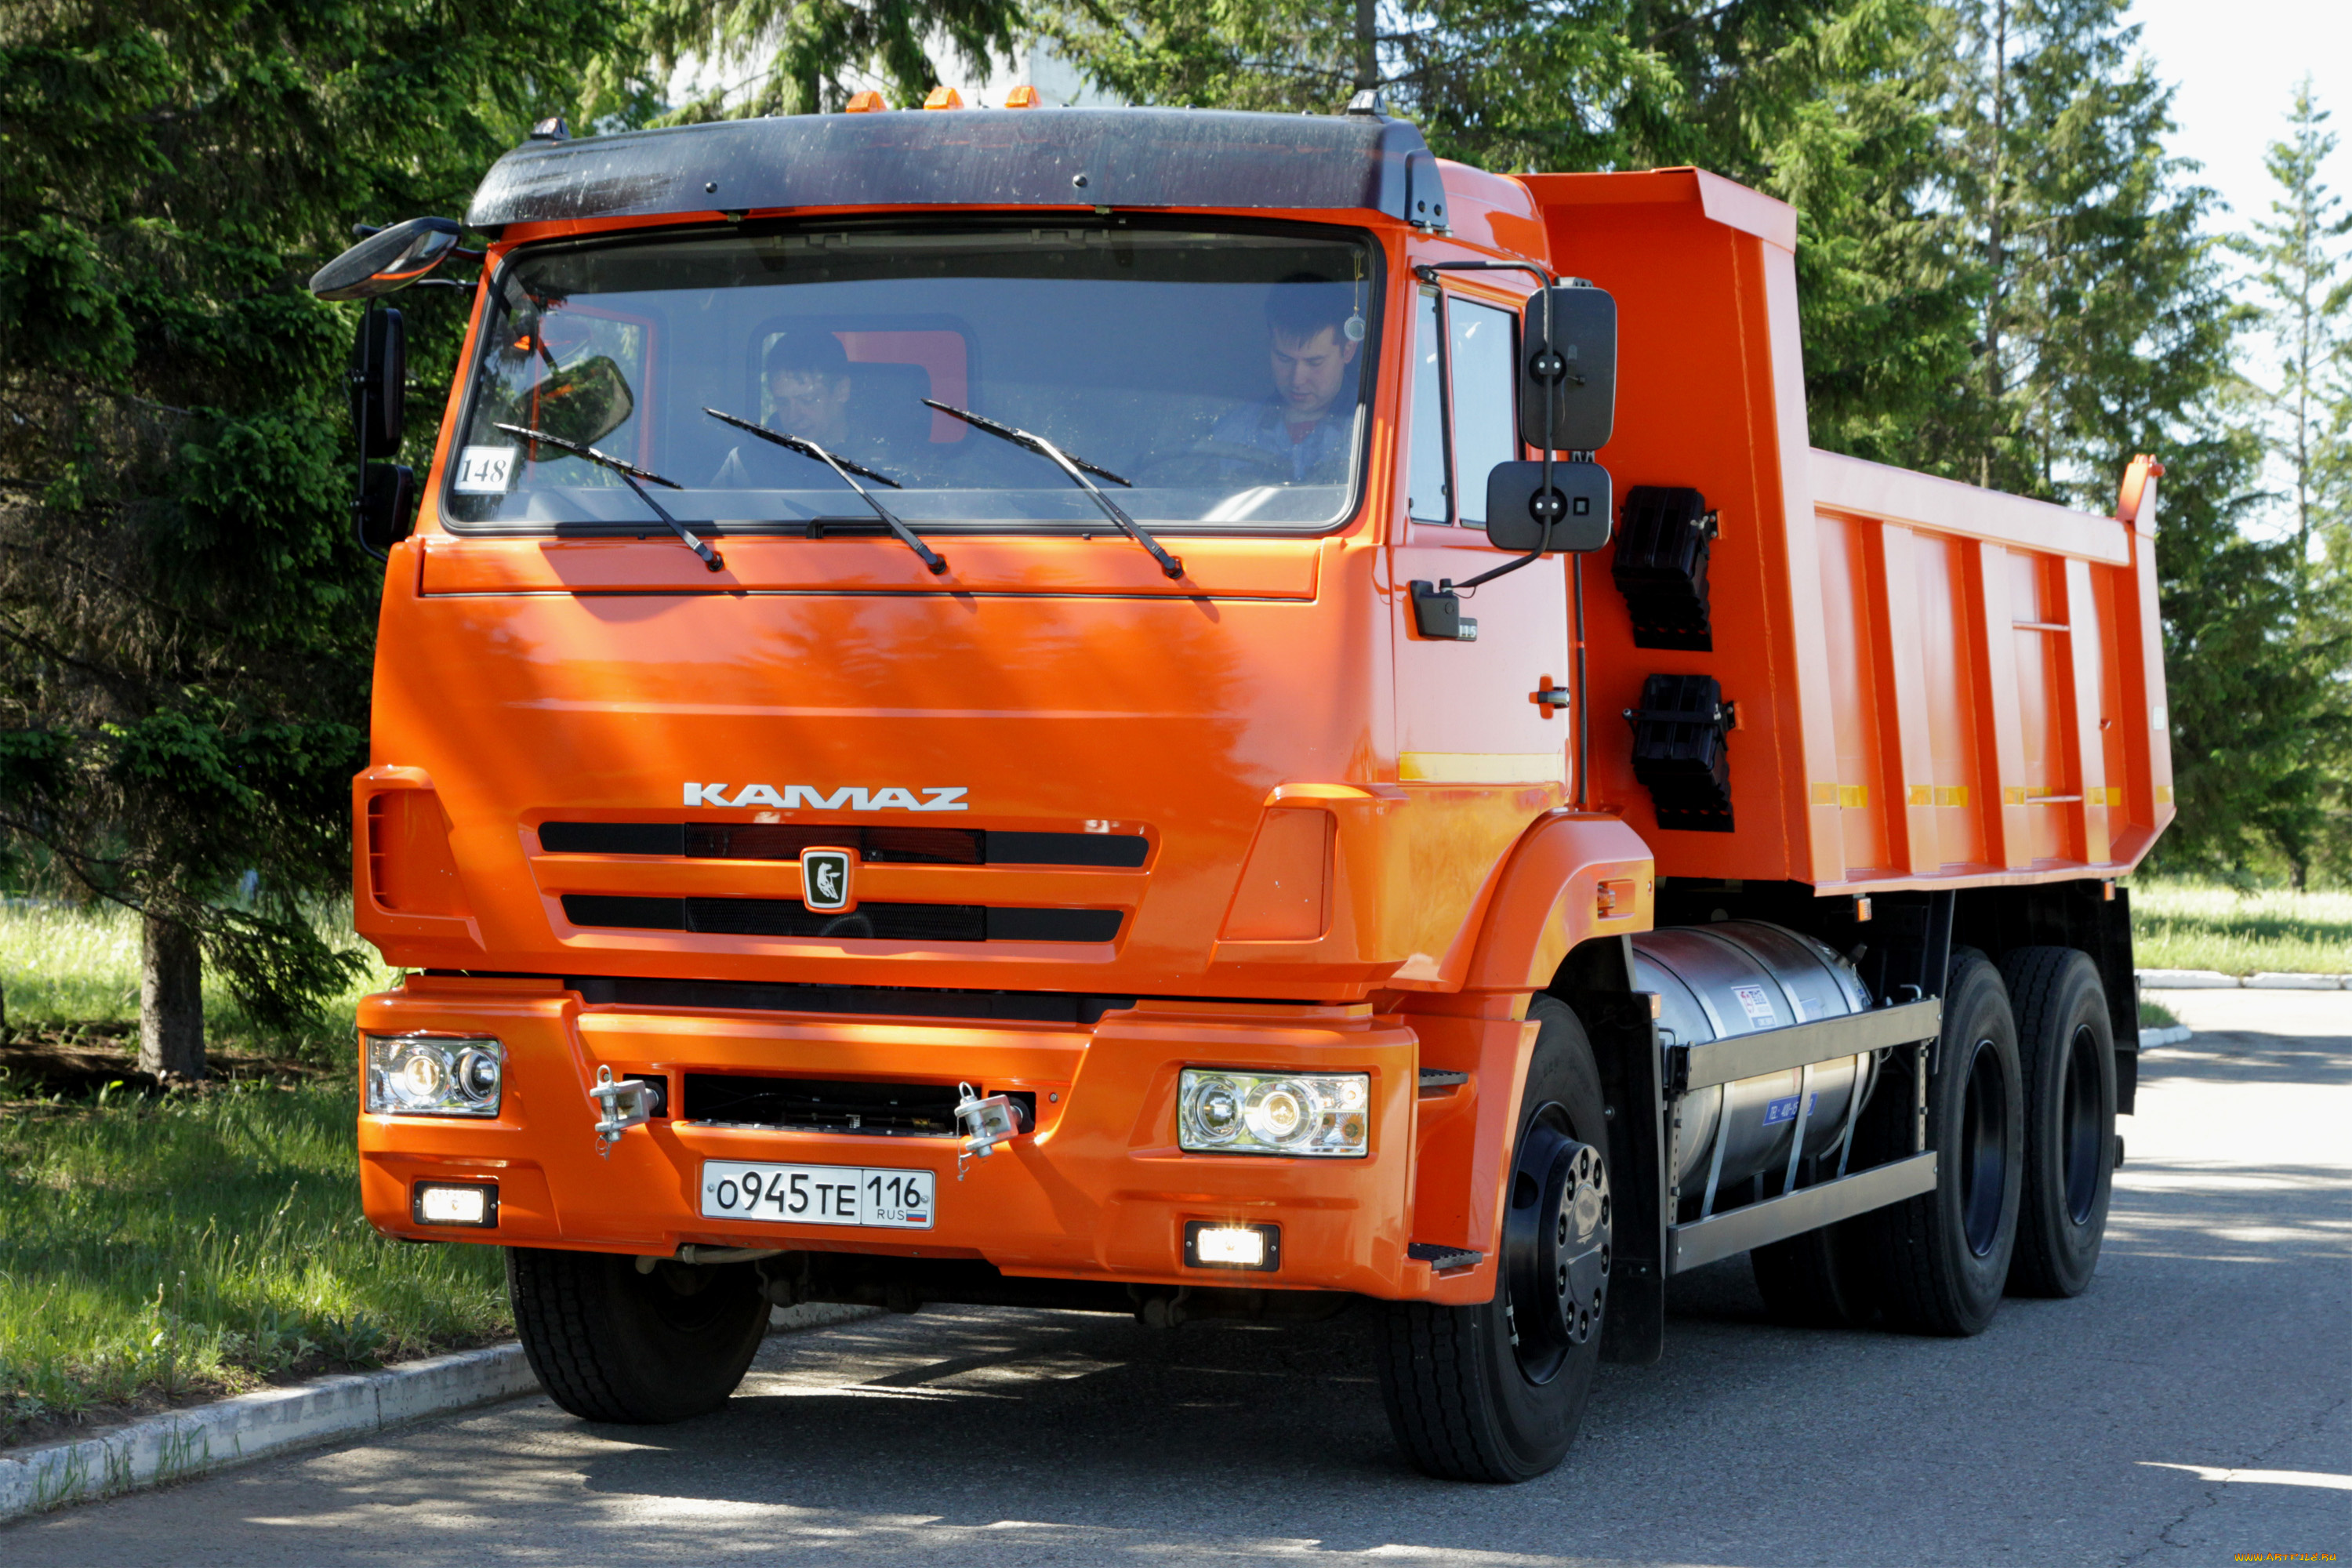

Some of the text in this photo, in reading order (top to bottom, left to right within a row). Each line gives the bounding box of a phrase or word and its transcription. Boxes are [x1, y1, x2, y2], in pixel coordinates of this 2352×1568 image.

[459, 459, 506, 483] 148
[683, 782, 969, 812] KAMAZ
[867, 1175, 921, 1208] 116
[877, 1208, 905, 1221] RUS
